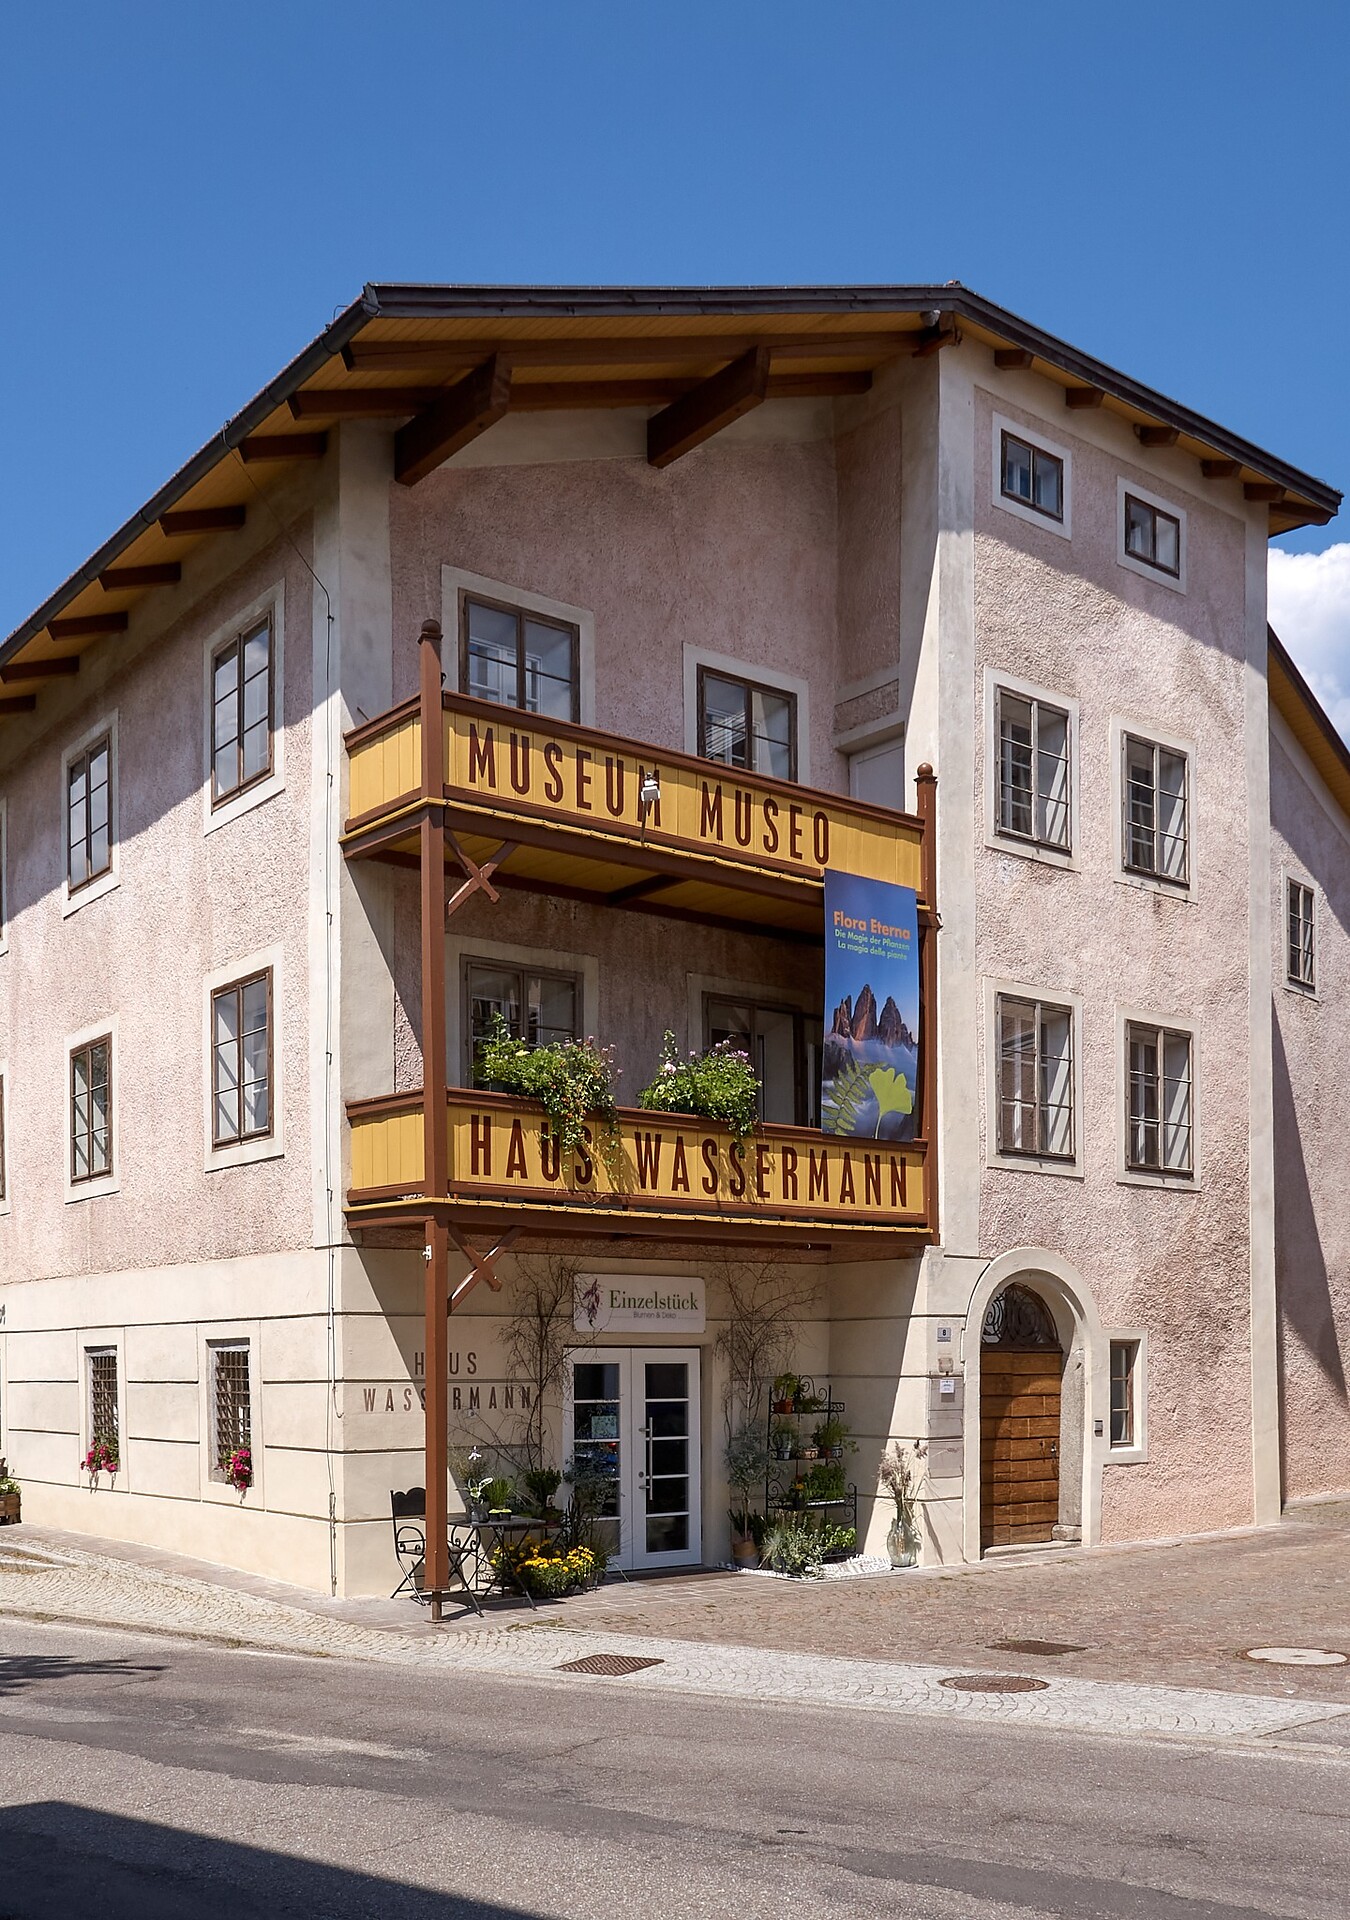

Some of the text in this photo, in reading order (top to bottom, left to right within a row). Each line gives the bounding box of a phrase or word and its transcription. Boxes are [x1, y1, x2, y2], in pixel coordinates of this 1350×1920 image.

[469, 723, 830, 864] MUSEUM MUSEO
[834, 911, 910, 940] Flora Eterna
[835, 929, 910, 950] Die Magie der Pflanzen
[838, 940, 907, 960] La magia delle piante
[470, 1114, 907, 1208] HAUS WASSERMANN
[609, 1290, 699, 1310] Einzelstück
[656, 1311, 661, 1319] &
[414, 1352, 477, 1375] HUS
[363, 1386, 531, 1412] WASSRMANN
